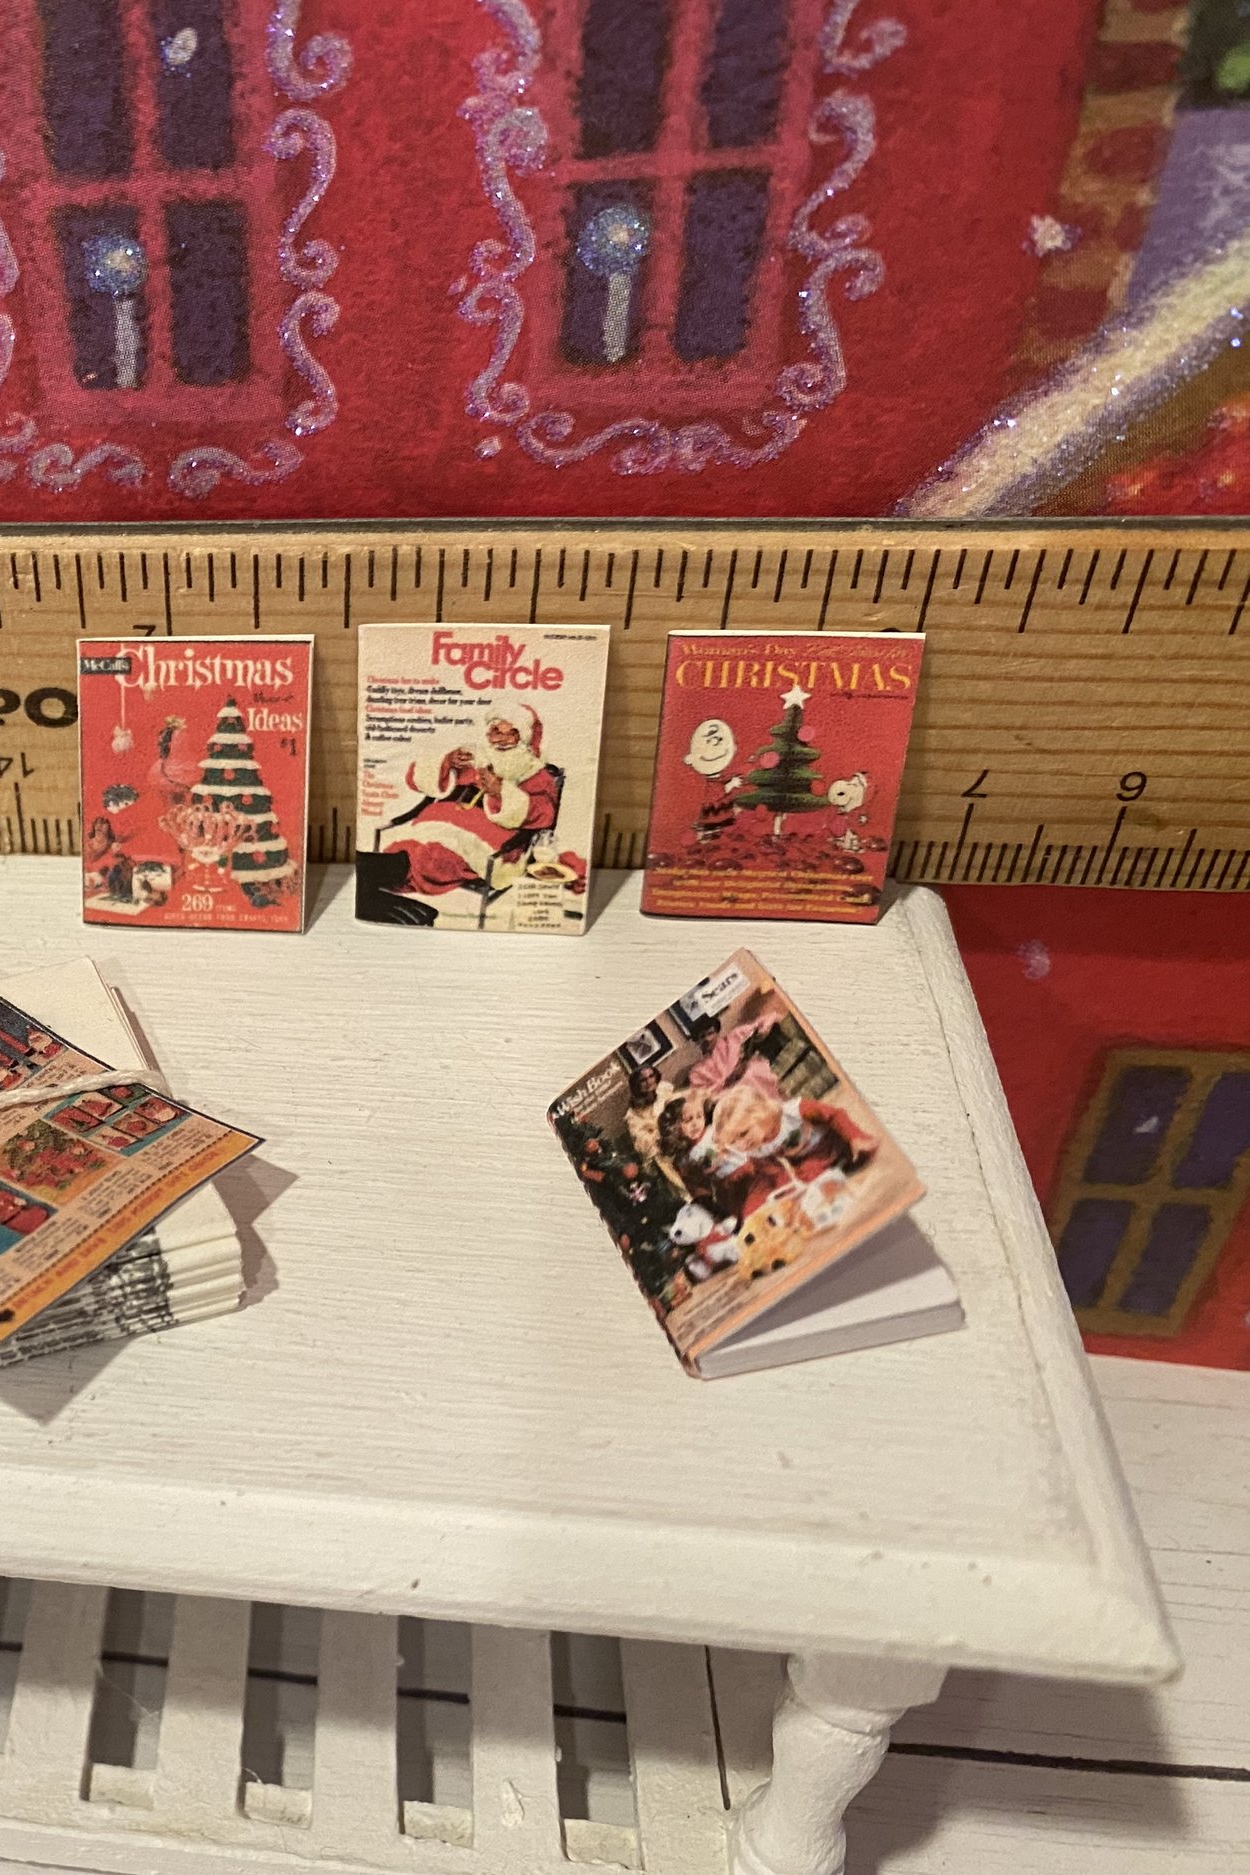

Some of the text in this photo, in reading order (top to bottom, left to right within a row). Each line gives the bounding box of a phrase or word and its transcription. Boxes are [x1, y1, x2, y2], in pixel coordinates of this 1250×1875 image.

[431, 631, 527, 665] Family
[115, 644, 293, 690] Christmas
[463, 659, 565, 690] Circle
[675, 659, 913, 691] CHRISTMAS
[247, 707, 303, 733] Ideas
[961, 769, 989, 798] 7
[1116, 771, 1147, 801] 6
[182, 893, 213, 911] 269
[702, 973, 738, 999] Sears
[557, 1088, 588, 1117] Wish
[587, 1062, 622, 1094] Book
